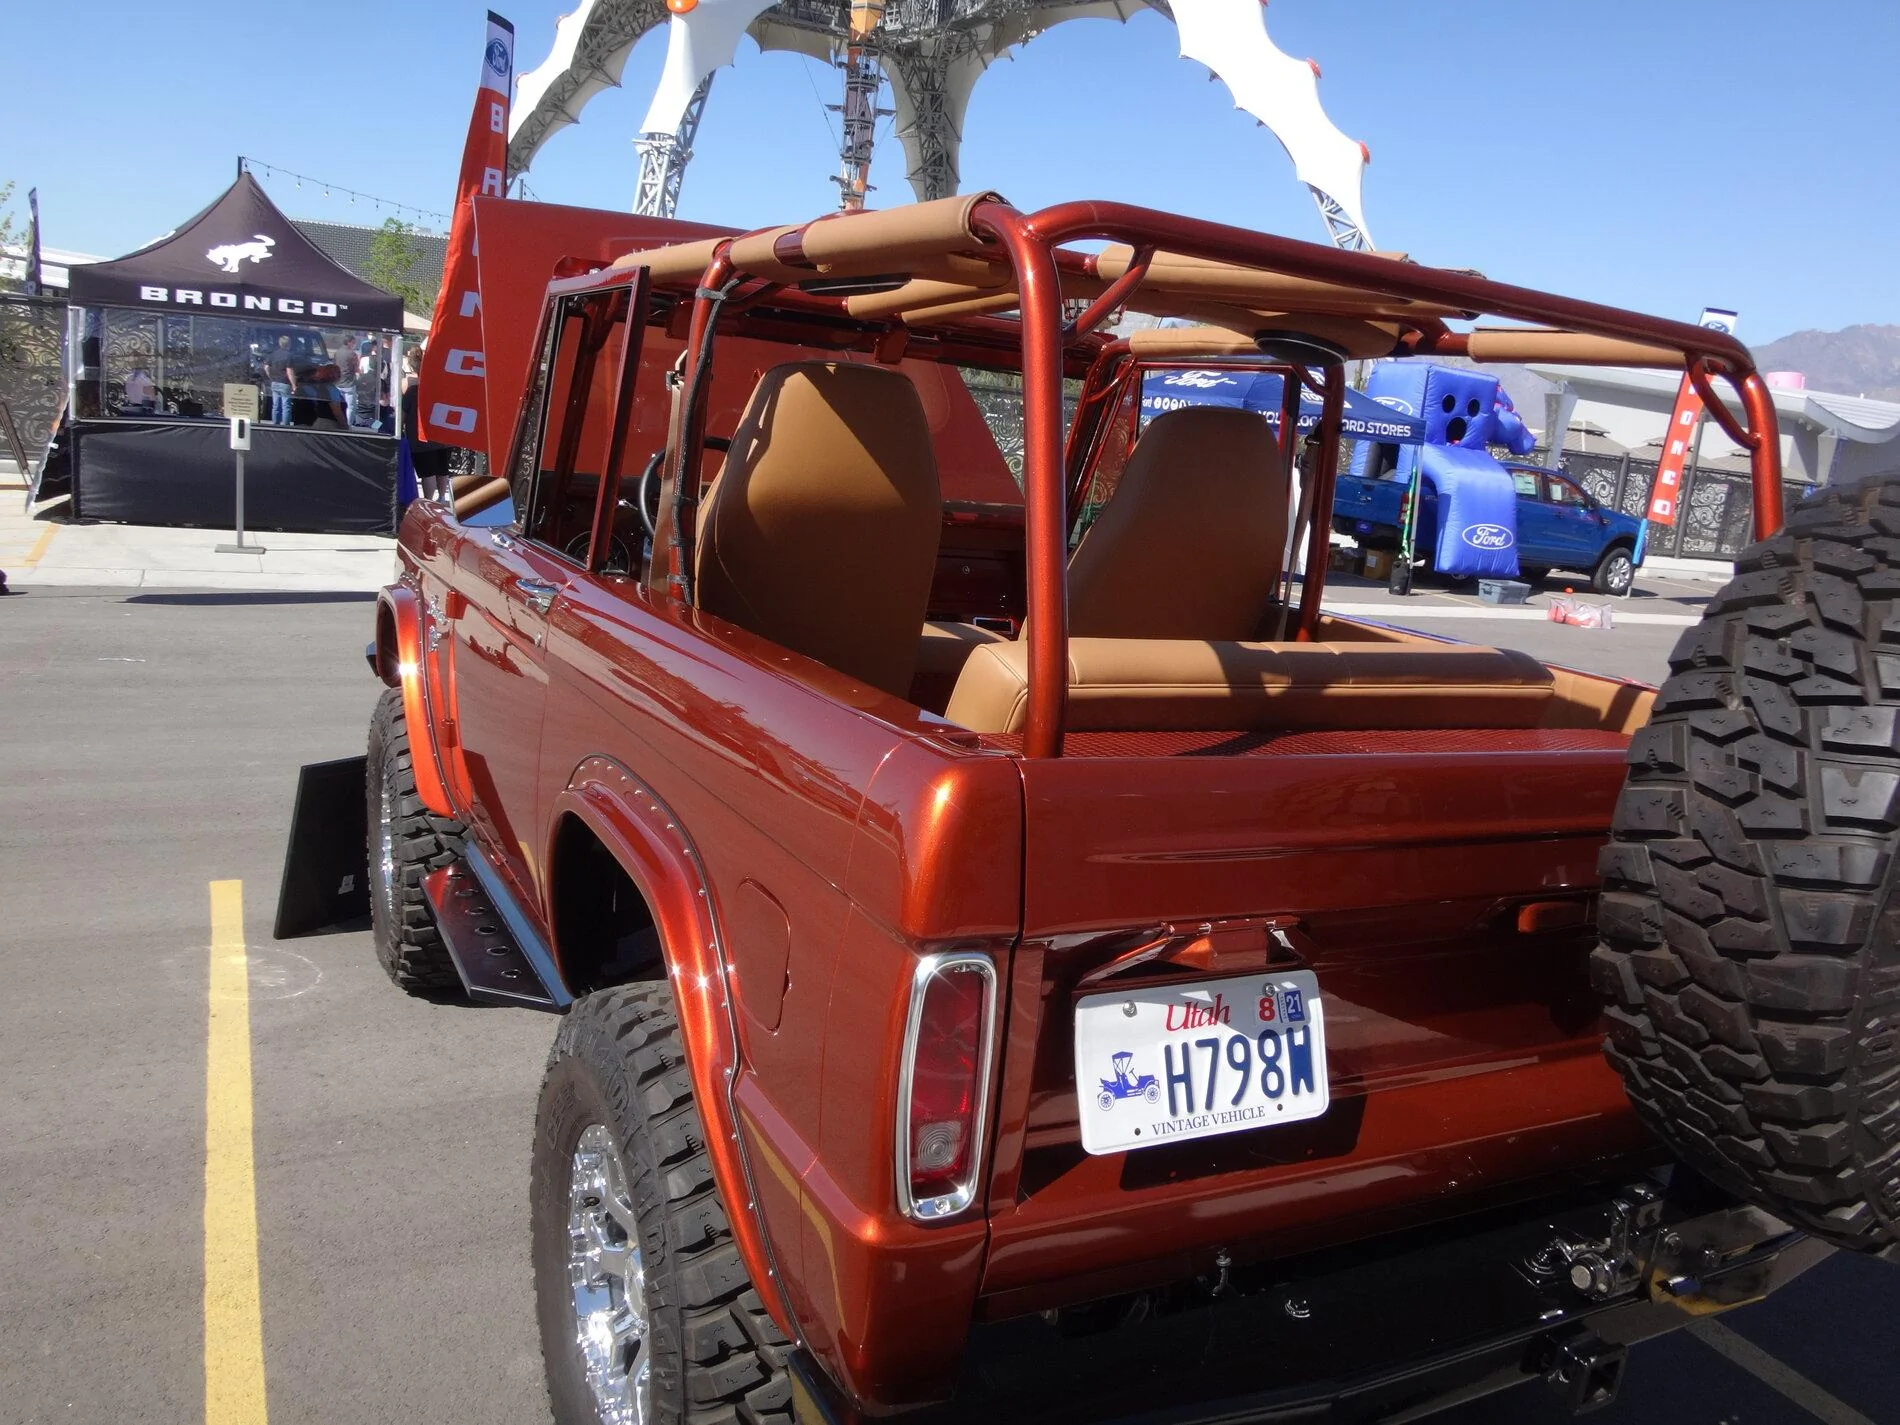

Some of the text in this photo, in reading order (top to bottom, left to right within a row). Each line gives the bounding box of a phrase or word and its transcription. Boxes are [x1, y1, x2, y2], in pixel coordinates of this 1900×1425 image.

[1342, 419, 1365, 432] ORD
[1366, 421, 1411, 437] STORES
[1472, 526, 1505, 547] Ford
[1165, 993, 1231, 1032] Utah
[1259, 997, 1276, 1022] 8
[1286, 993, 1302, 1014] 21
[1164, 1024, 1315, 1117] H798W
[1152, 1105, 1266, 1136] VINTAGE VEHICLE
